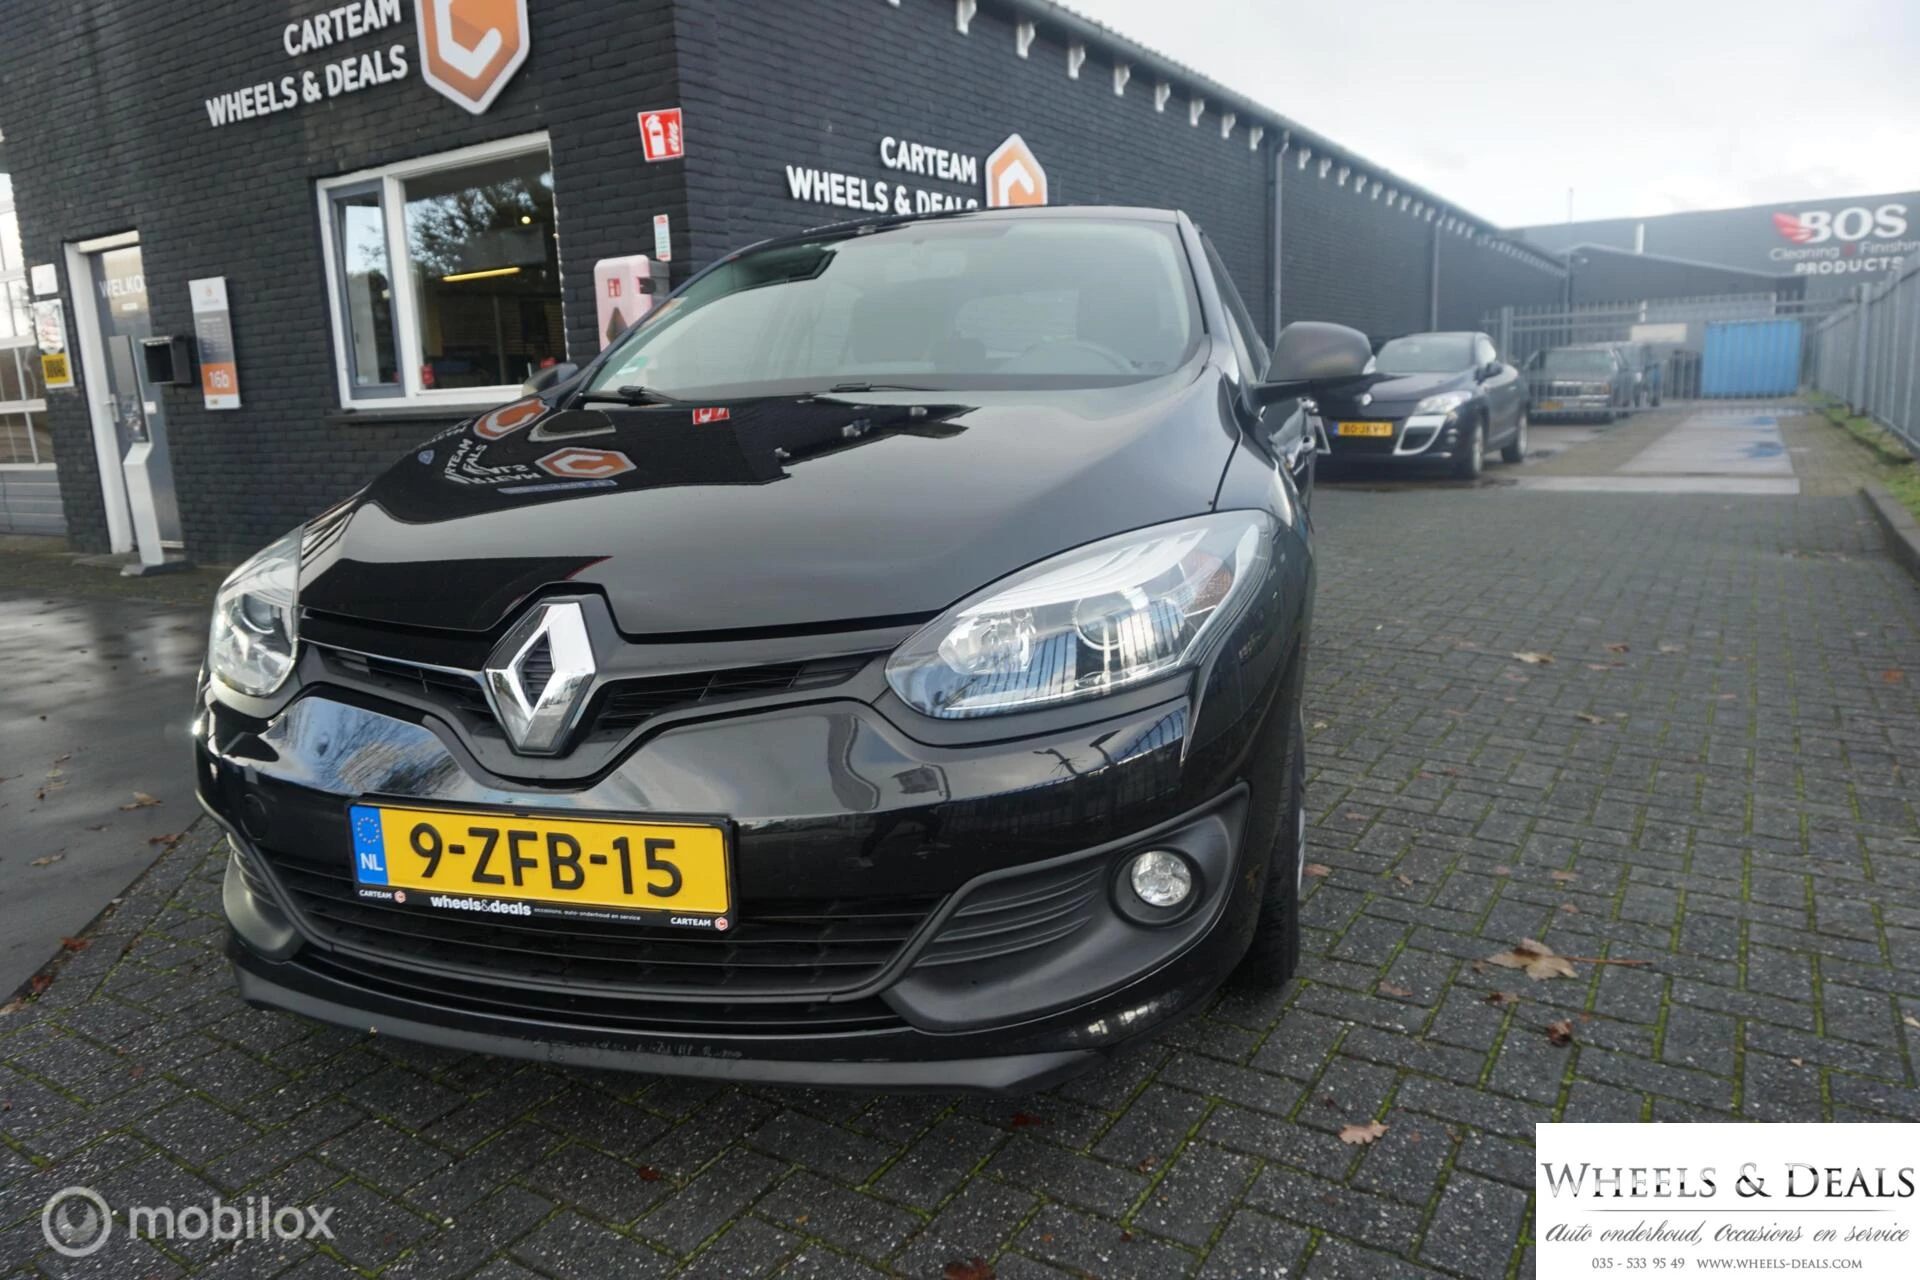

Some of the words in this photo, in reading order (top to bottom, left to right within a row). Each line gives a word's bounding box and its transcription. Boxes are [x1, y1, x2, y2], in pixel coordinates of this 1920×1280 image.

[283, 0, 401, 56] CARTEAM
[206, 76, 298, 127] WHEELS
[302, 70, 322, 103] &
[325, 44, 408, 97] DEALS
[880, 136, 977, 184] CARTEAM
[786, 165, 888, 213] WHEELS
[894, 185, 912, 215] &
[1799, 204, 1908, 243] BOS
[1794, 255, 1904, 275] PRODUCTS
[360, 852, 384, 872] NL
[409, 822, 682, 898] 9-ZFB-15
[358, 889, 393, 900] CARTEAM
[670, 917, 711, 928] CARTEAM
